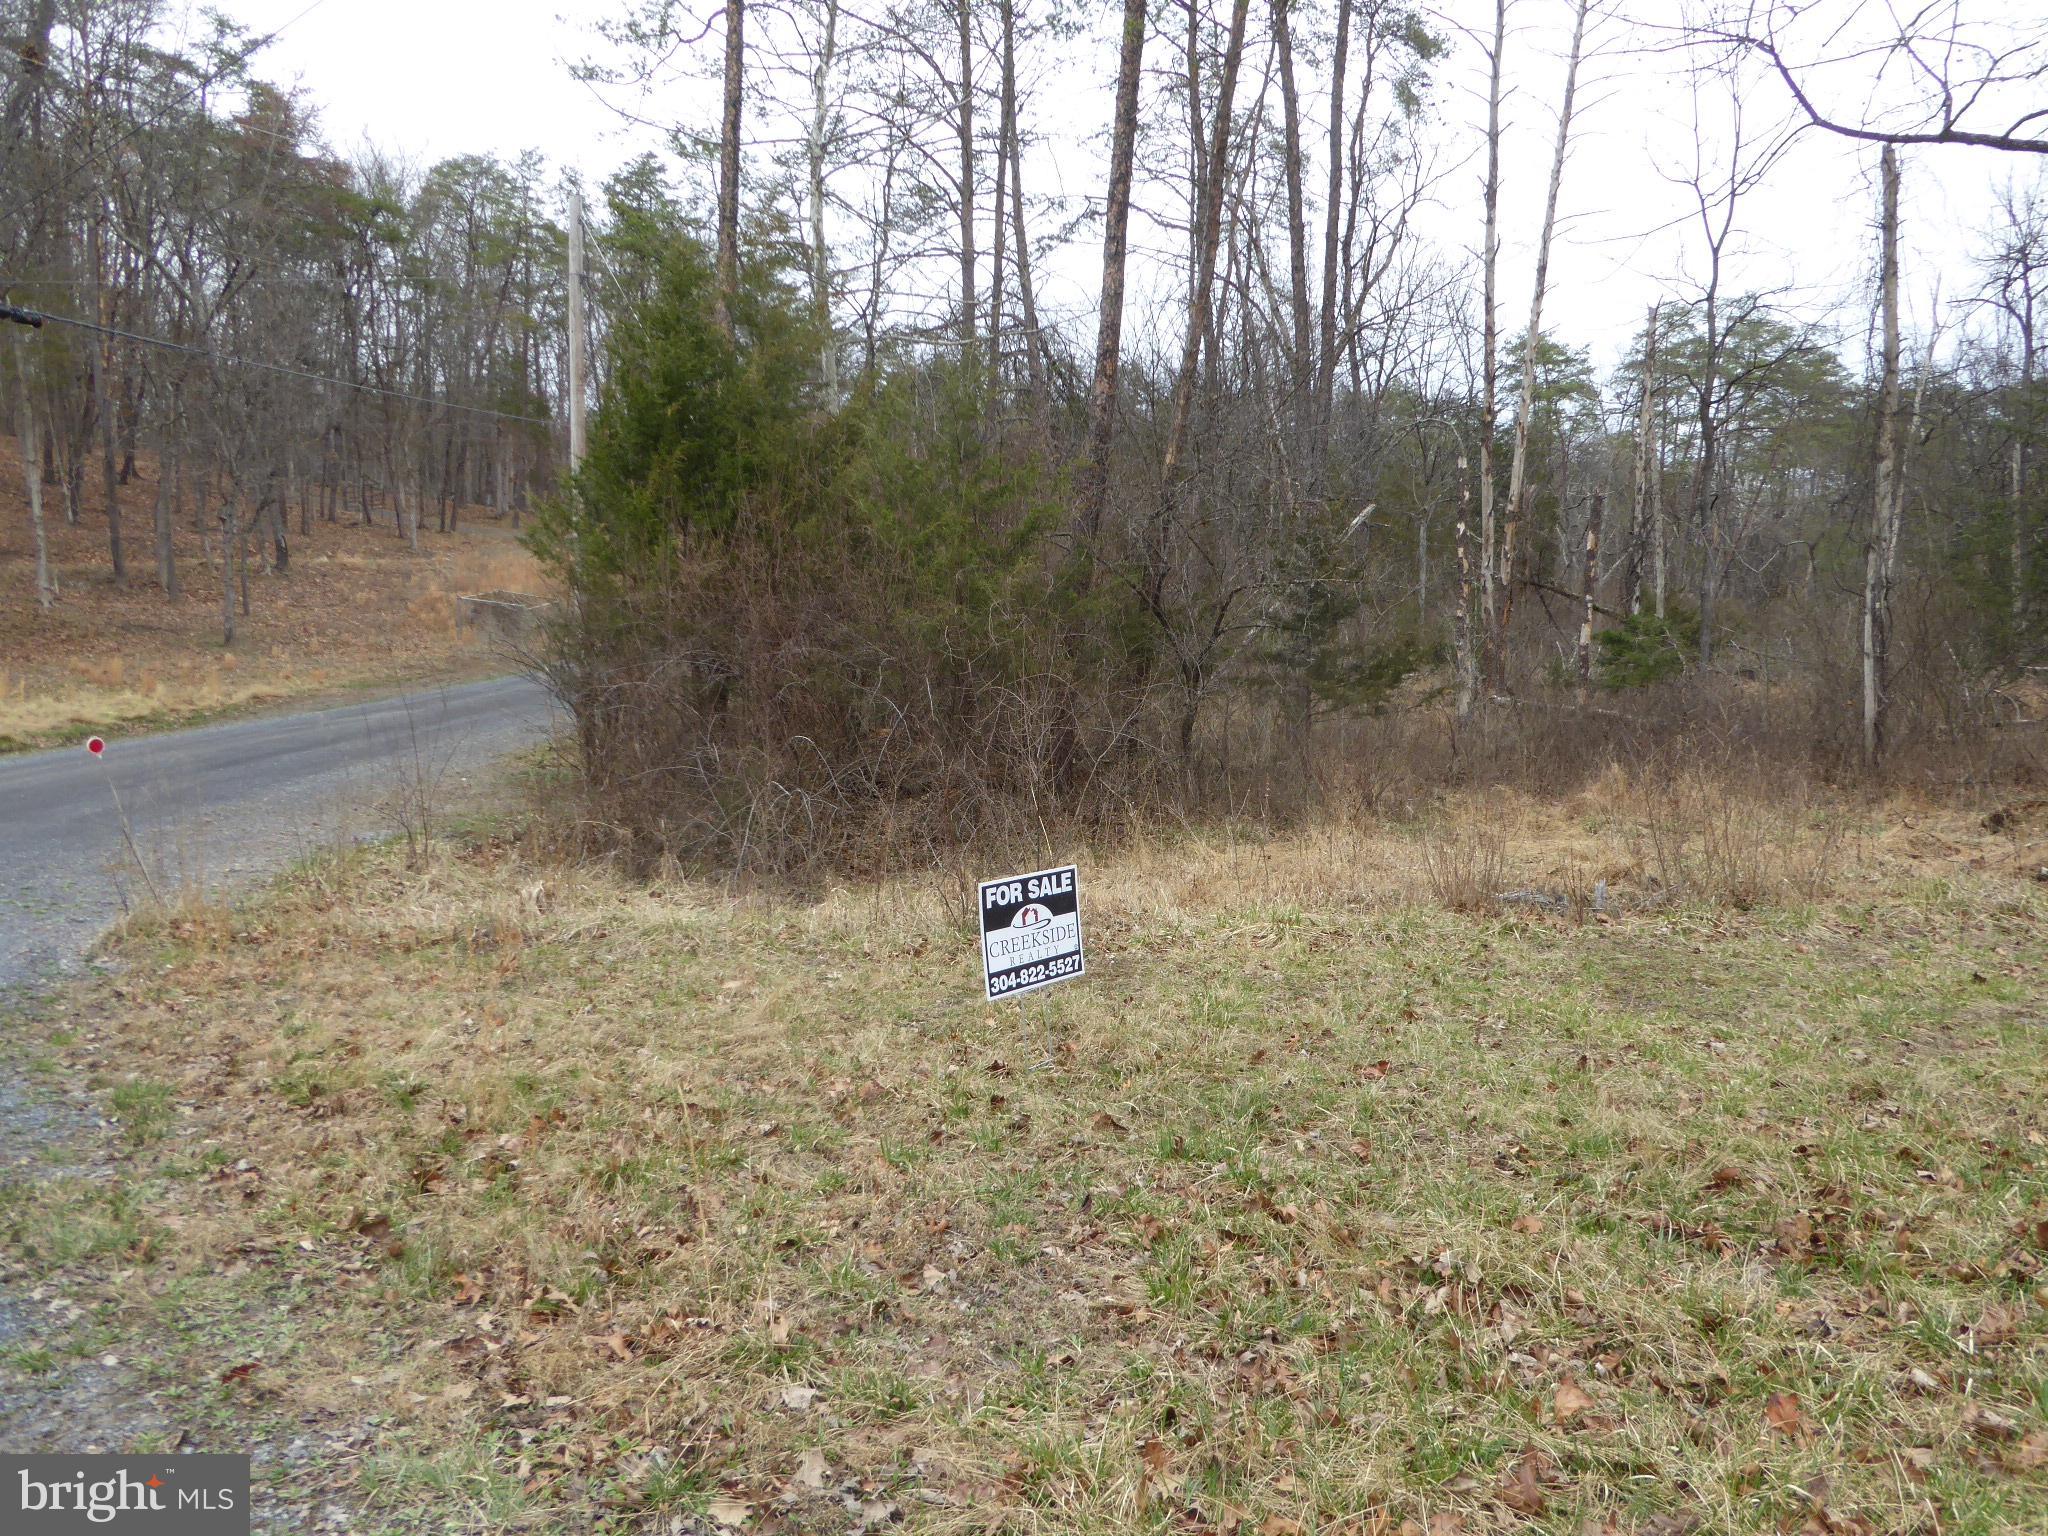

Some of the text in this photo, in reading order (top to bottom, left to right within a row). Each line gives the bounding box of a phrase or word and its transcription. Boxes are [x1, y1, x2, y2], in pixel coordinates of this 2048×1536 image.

[985, 872, 1073, 909] FOR SALE
[989, 923, 1076, 958] CREEKSIDE
[1009, 945, 1060, 967] REALTY
[990, 954, 1080, 993] 304-822-5527
